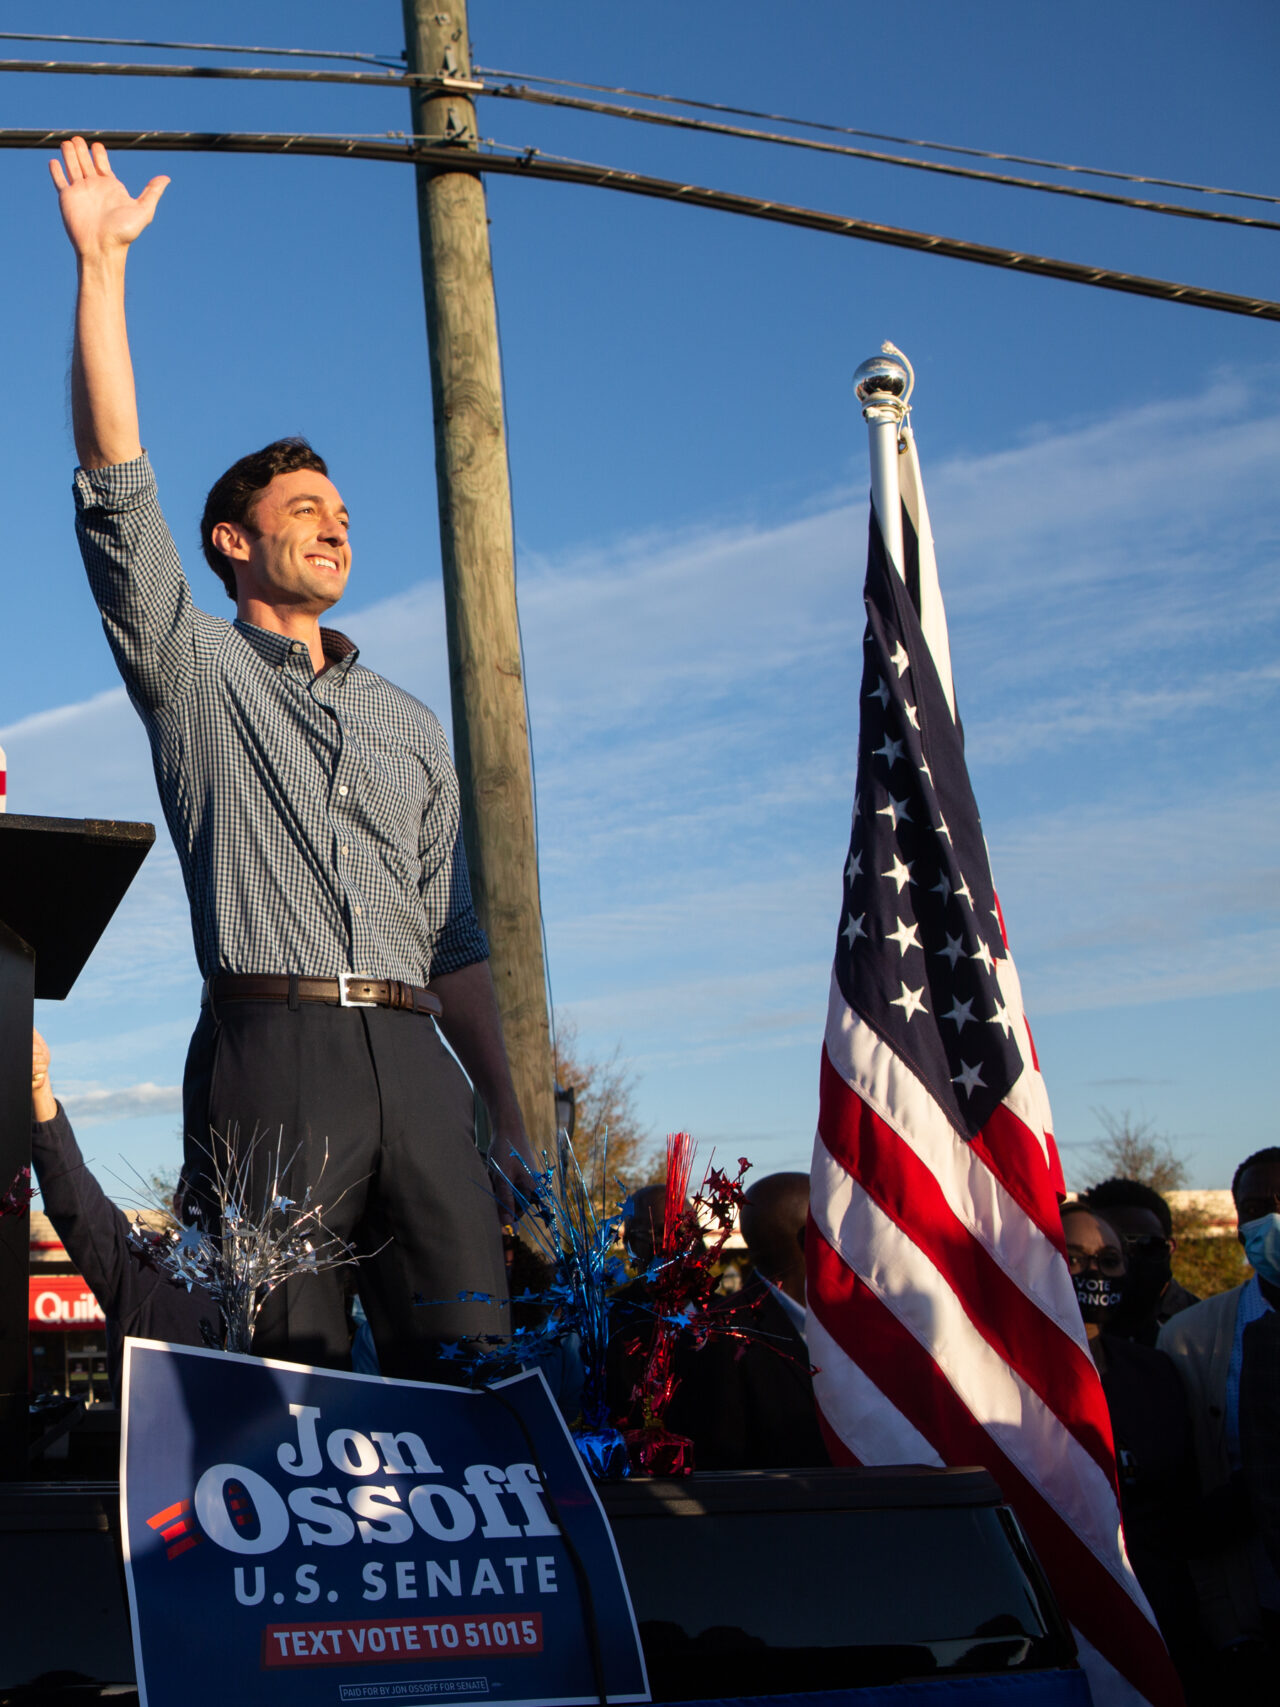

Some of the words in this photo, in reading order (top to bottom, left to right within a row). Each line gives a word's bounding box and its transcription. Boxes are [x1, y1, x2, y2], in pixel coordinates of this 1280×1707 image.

[1074, 1277, 1111, 1292] VOTE
[276, 1403, 444, 1478] Jon
[194, 1463, 563, 1555] Ossoff
[234, 1564, 338, 1606] U.S.
[363, 1556, 558, 1601] SENATE
[273, 1629, 343, 1657] TEXT
[347, 1625, 421, 1653] VOTE
[422, 1623, 459, 1649] TO
[465, 1620, 538, 1647] 51015
[343, 1688, 362, 1697] PAID
[363, 1687, 379, 1696] FOR
[380, 1686, 390, 1695] BY
[391, 1684, 407, 1694] JON
[408, 1683, 439, 1693] OSSOFF
[440, 1682, 455, 1691] FOR
[456, 1681, 486, 1690] SENATE
